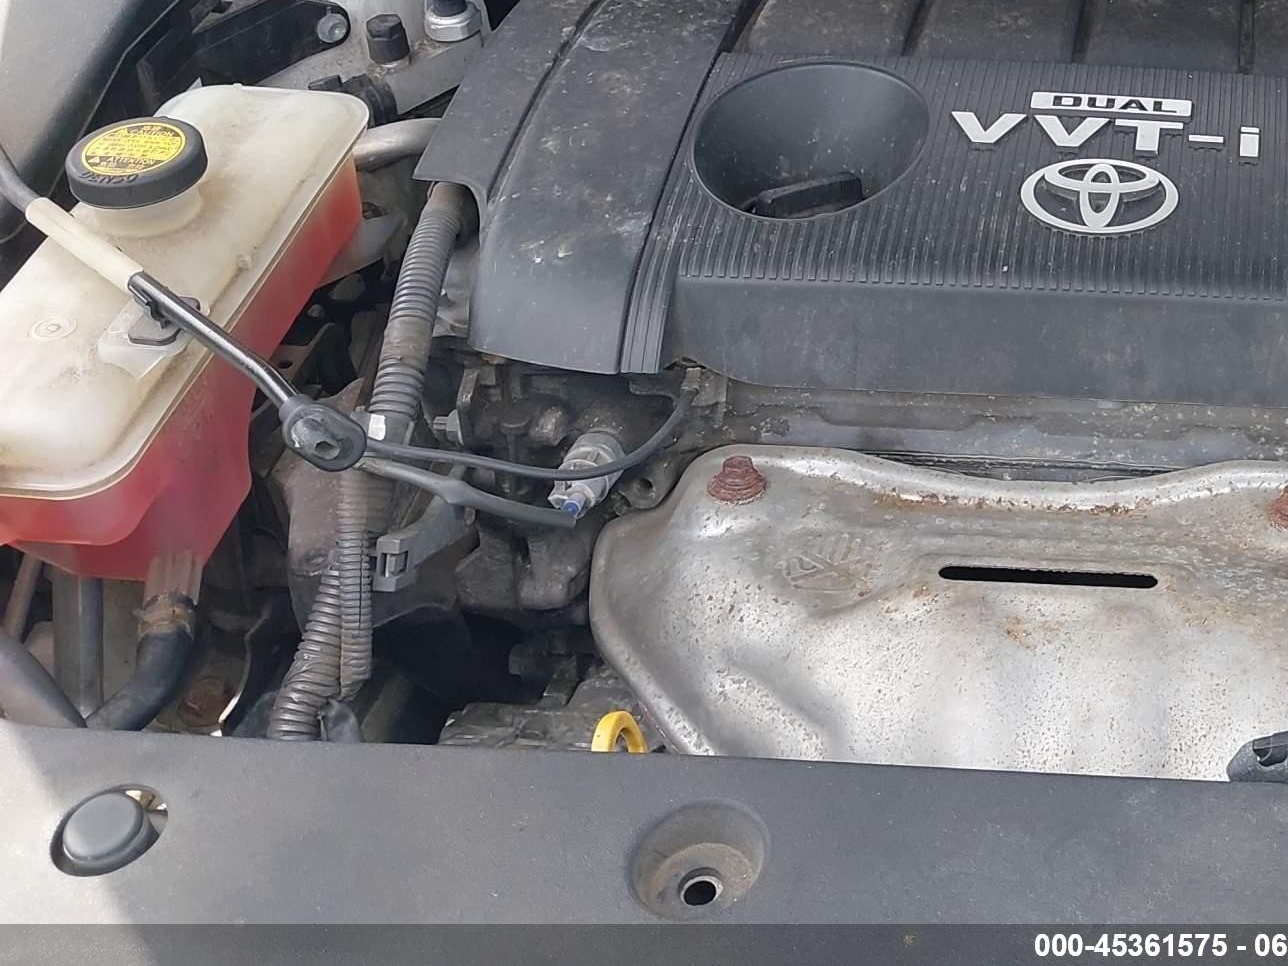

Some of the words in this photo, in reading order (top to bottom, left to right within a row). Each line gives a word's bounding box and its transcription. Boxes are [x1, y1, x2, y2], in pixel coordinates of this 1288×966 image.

[1052, 95, 1178, 114] DUAL
[130, 129, 174, 137] CAUTION
[951, 111, 1260, 157] VVT-i
[107, 156, 156, 165] ATTENTION
